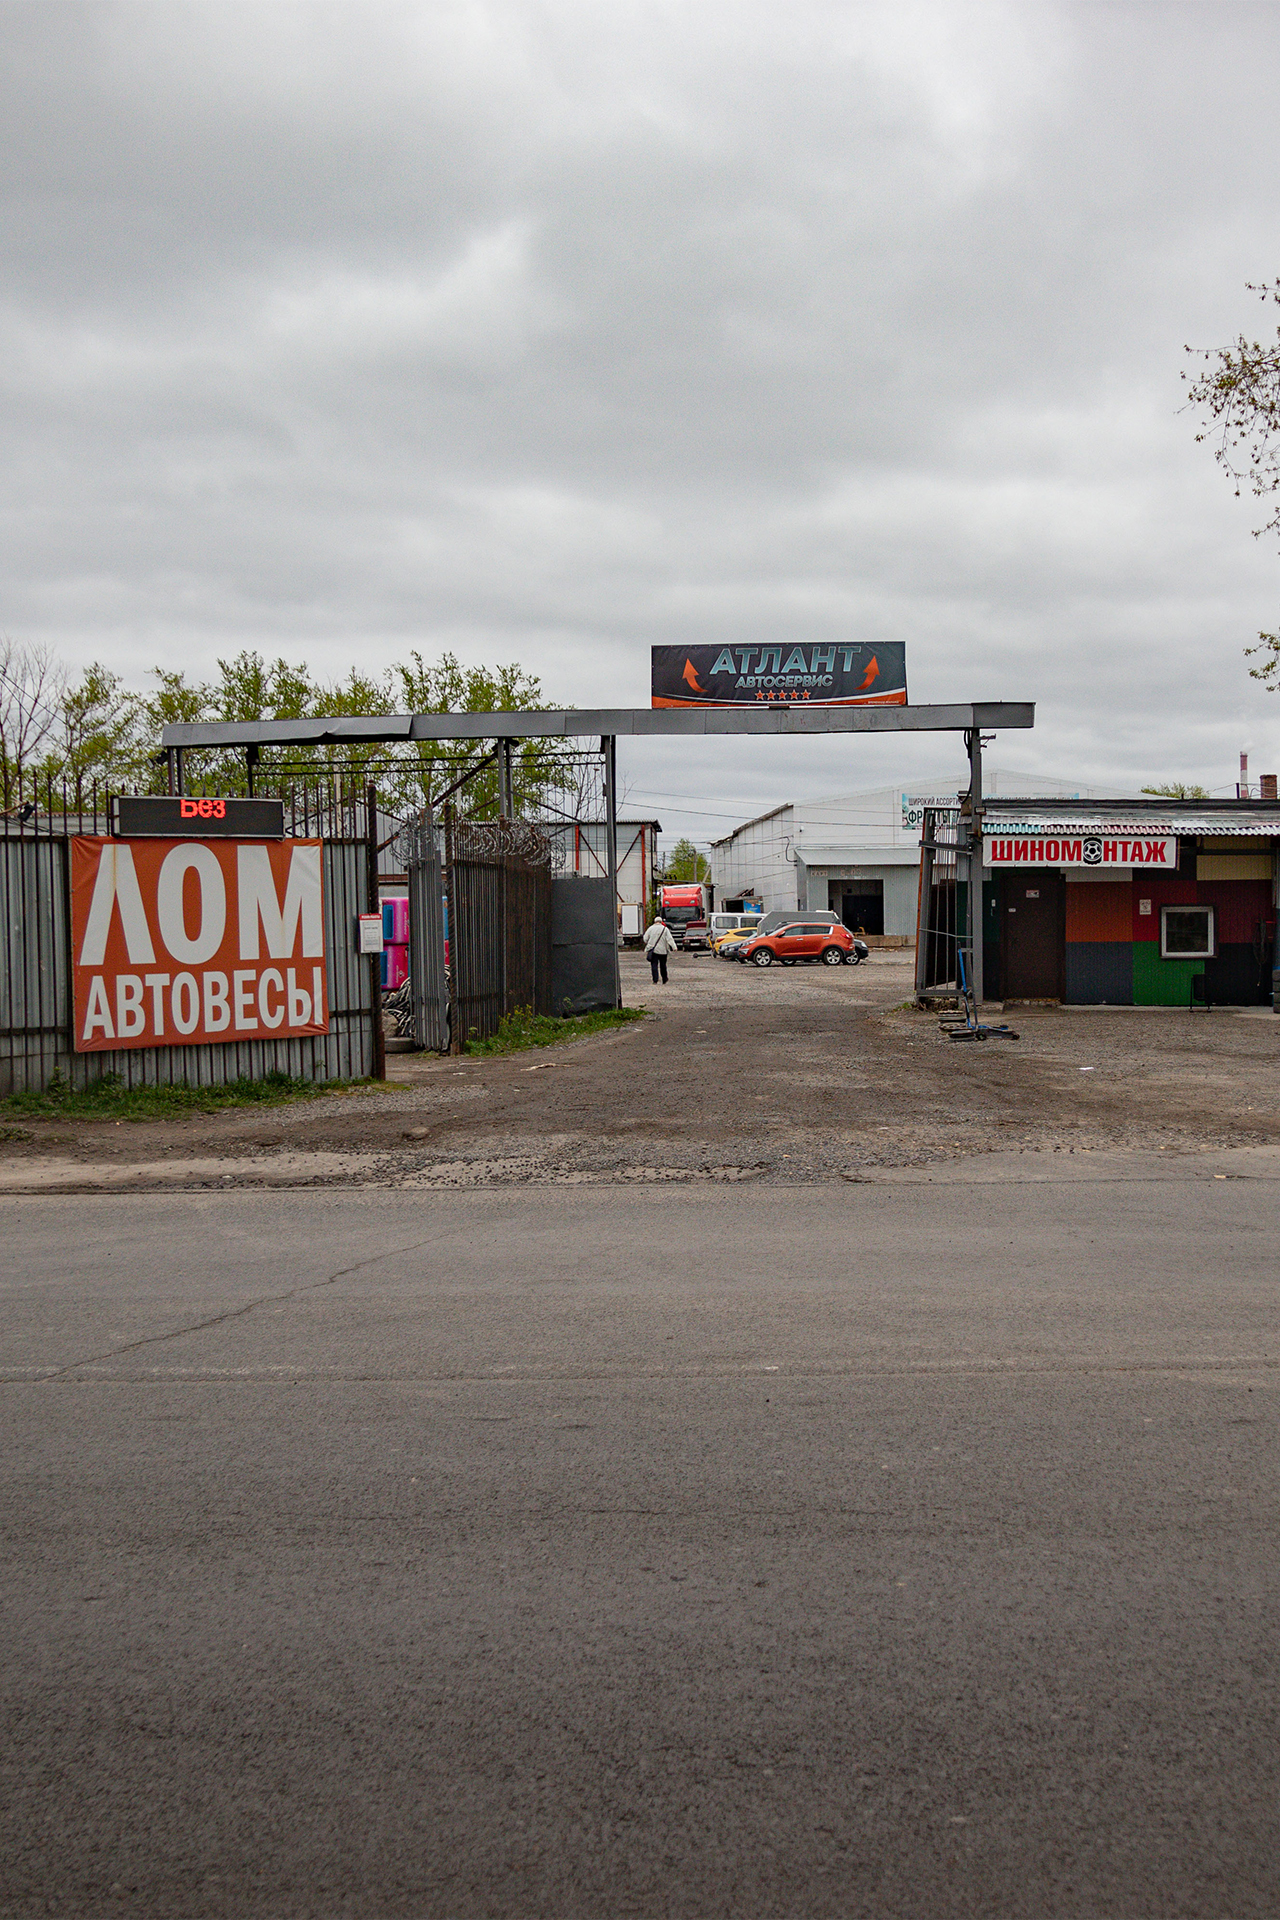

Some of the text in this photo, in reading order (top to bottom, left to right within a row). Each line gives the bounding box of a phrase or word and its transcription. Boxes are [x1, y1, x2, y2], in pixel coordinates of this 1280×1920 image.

[708, 645, 862, 675] АТЛАНТ
[734, 674, 834, 689] АВТОСЕРВИС
[908, 796, 960, 806] ШИРОКИЙ АССОРТ
[79, 842, 324, 966] ЛОМ
[82, 966, 324, 1041] АВТОВЕСЫ
